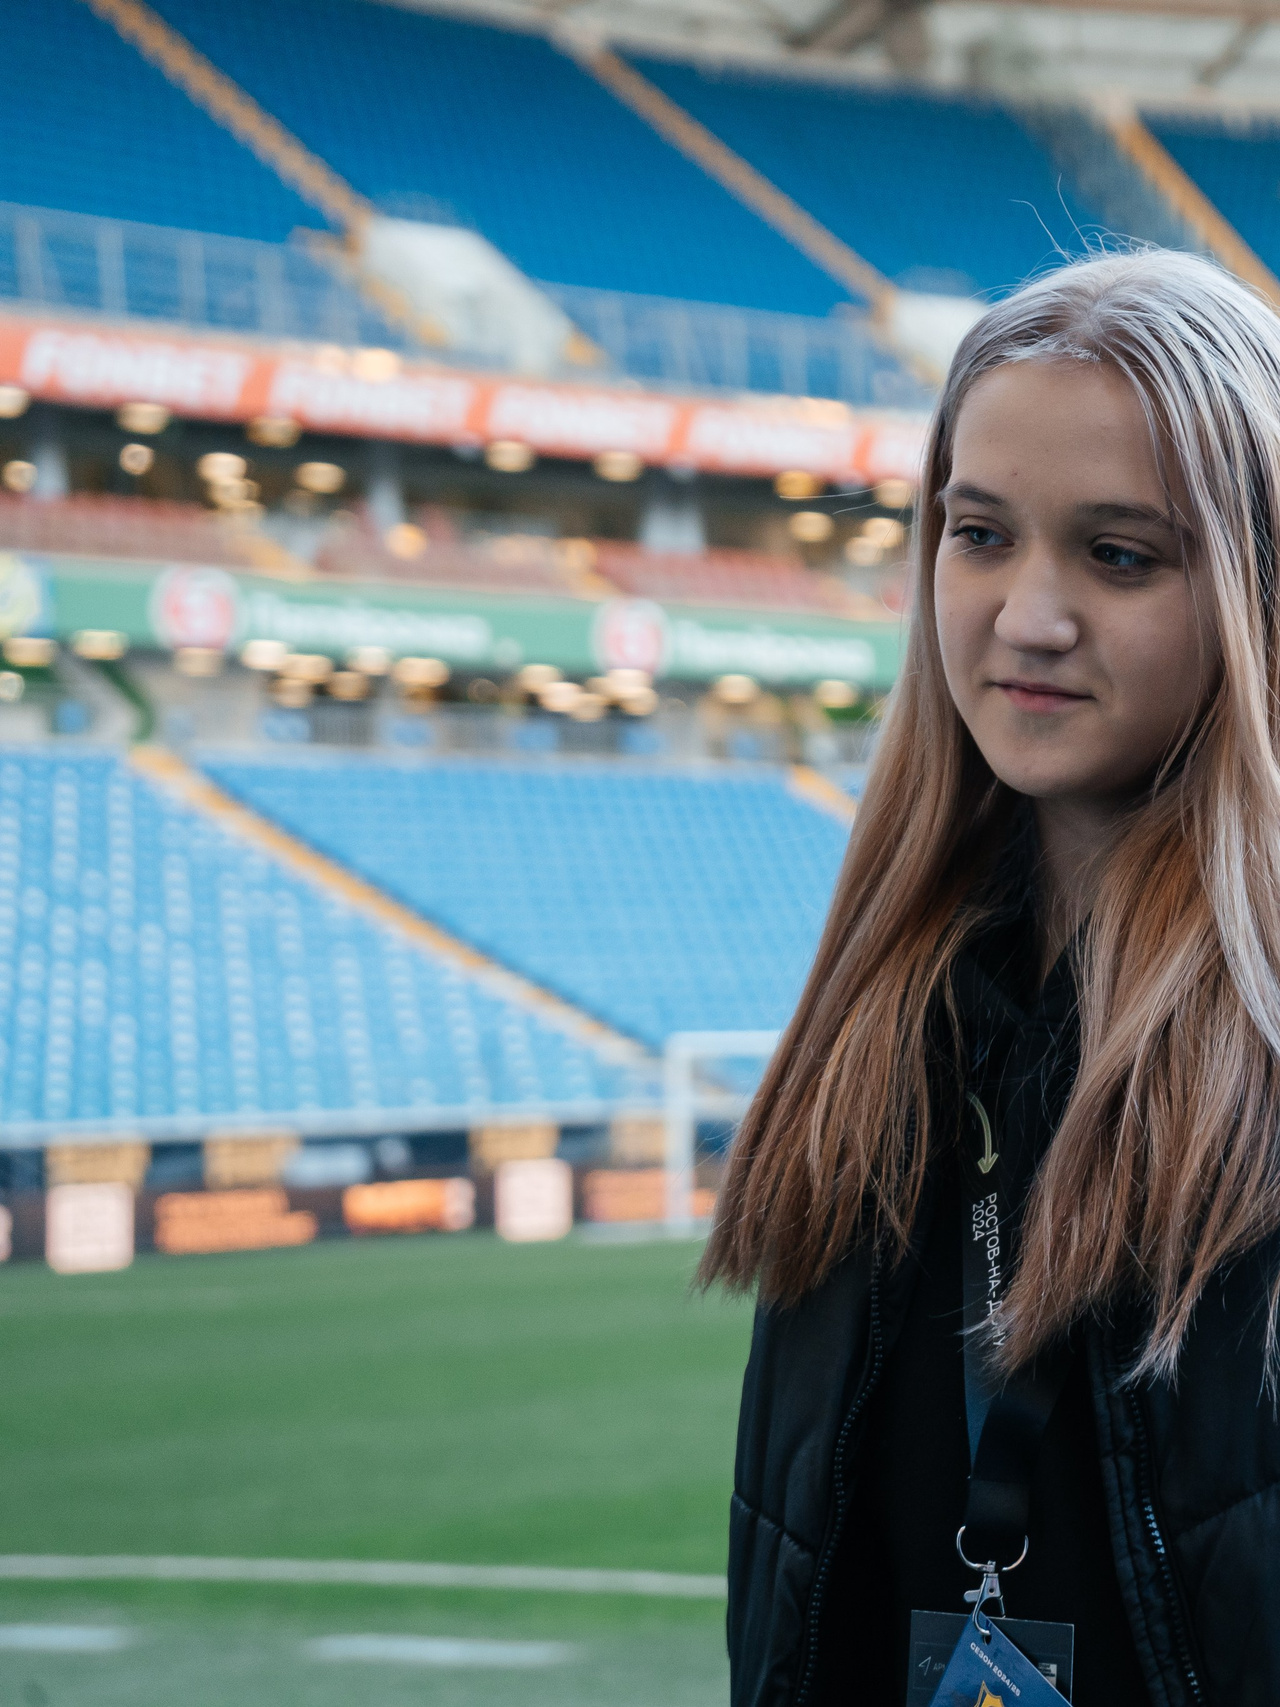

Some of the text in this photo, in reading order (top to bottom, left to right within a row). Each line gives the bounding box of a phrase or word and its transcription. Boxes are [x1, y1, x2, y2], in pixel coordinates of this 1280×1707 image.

[972, 1199, 986, 1242] 2024
[970, 1641, 1021, 1697] СЕЗОН 2024/25
